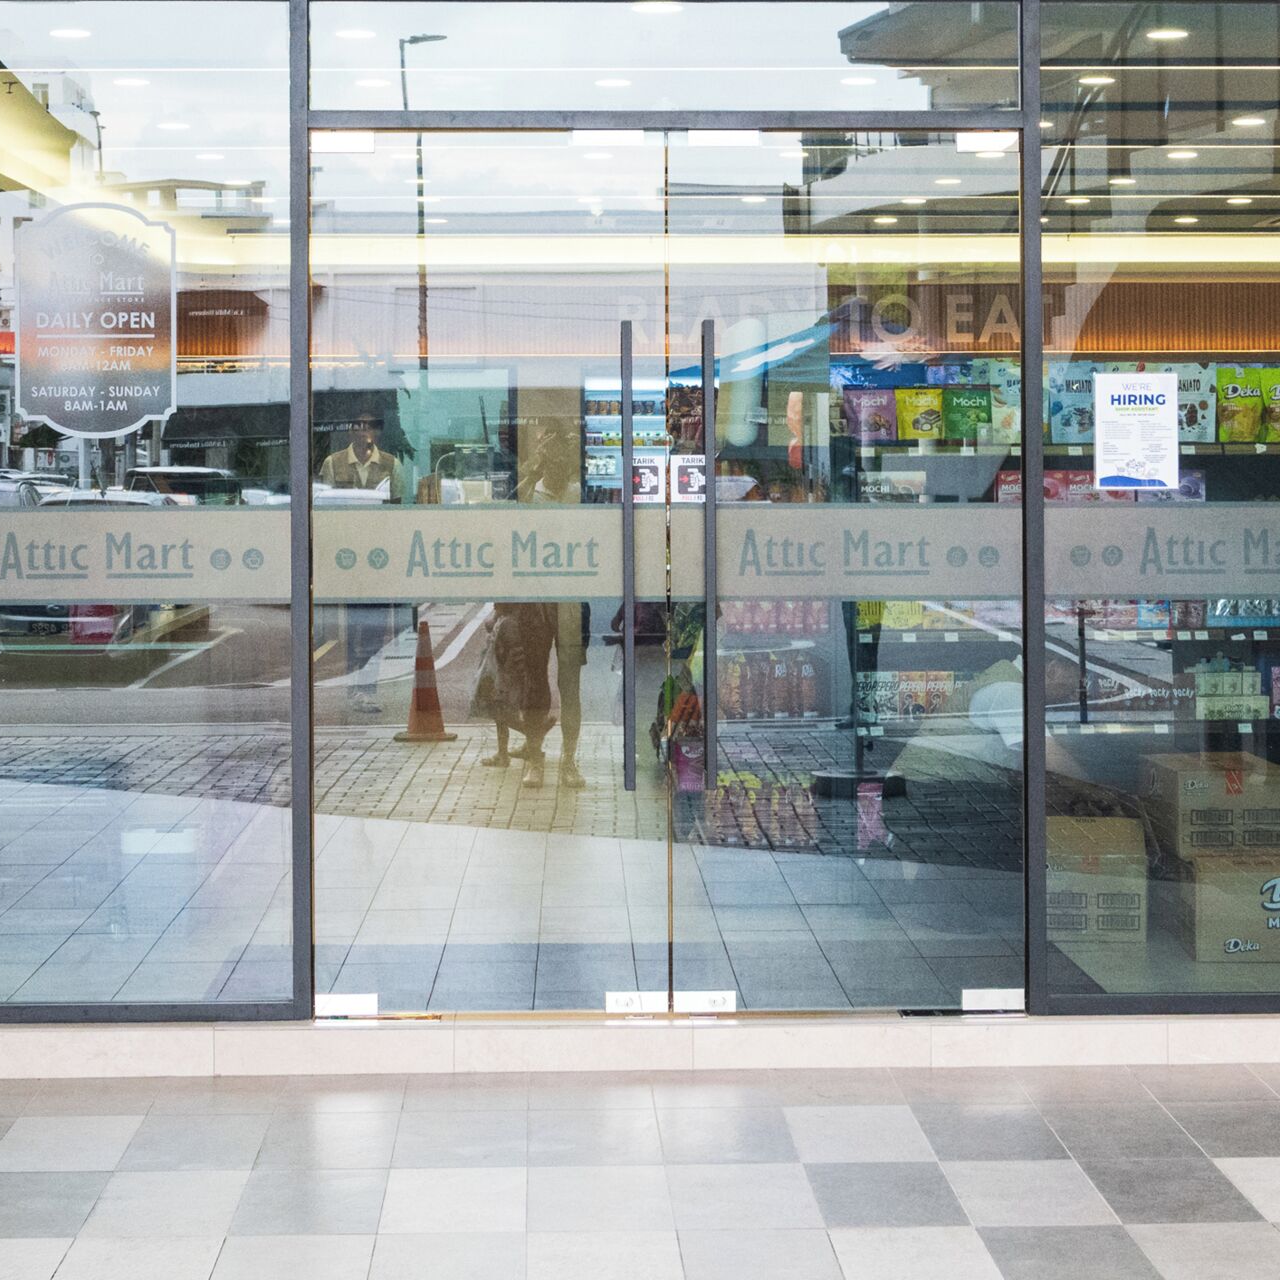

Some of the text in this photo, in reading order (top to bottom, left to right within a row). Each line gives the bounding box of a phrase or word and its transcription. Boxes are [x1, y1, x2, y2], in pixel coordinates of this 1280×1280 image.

[100, 271, 144, 291] Mart
[36, 311, 155, 329] DAILY OPEN
[38, 346, 96, 357] MONDAY
[109, 346, 154, 357] FRIDAY
[31, 386, 96, 398] SATURDAY
[109, 386, 160, 398] SUNDAY
[1222, 383, 1261, 400] Deka
[64, 400, 128, 411] 8AM-1AM
[853, 395, 888, 407] Mochi
[953, 395, 987, 407] Mochi
[1110, 394, 1166, 406] HIRING
[861, 485, 890, 494] MOCHI
[1069, 483, 1094, 492] MOCH
[0, 531, 194, 580] Attic Mart
[405, 529, 599, 577] Attic Mart
[738, 529, 931, 577] Attic Mart
[1139, 526, 1227, 575] Attic
[871, 681, 900, 692] PEPERO
[1224, 937, 1260, 954] Deka
